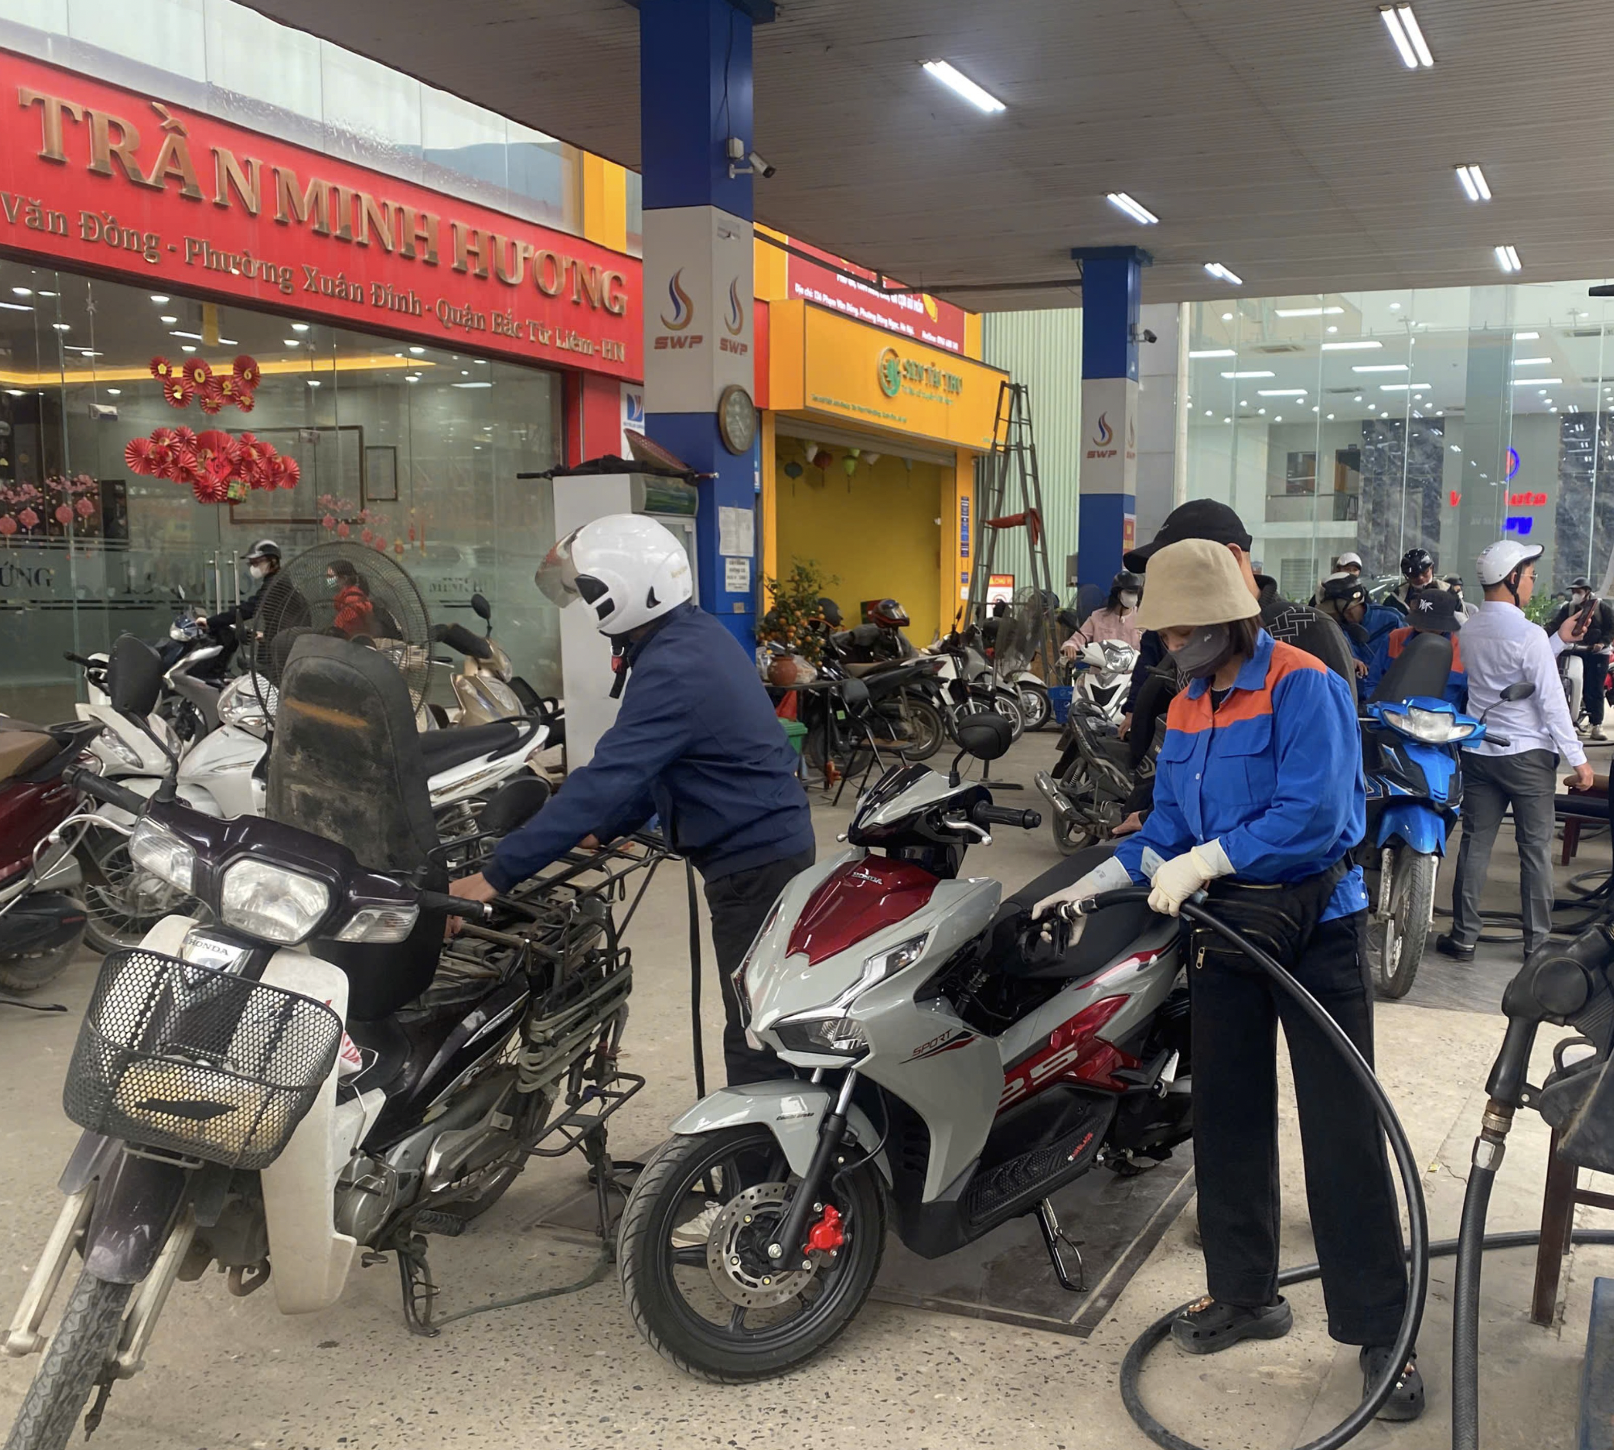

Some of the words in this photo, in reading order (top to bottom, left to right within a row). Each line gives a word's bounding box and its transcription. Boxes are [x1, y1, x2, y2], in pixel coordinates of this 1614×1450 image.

[17, 86, 265, 216] TRẦN
[271, 165, 441, 266] MINH
[450, 219, 628, 318] HƯƠNG
[0, 191, 69, 236] Văn
[78, 210, 161, 264] Đồng
[183, 235, 294, 295] Phường
[302, 264, 364, 303] Xuân
[435, 298, 486, 334] Quận
[491, 308, 523, 339] Bắc
[654, 334, 703, 350] SWP
[719, 337, 748, 356] SWP
[1086, 449, 1118, 459] SWP
[187, 938, 229, 957] HONDA
[912, 1028, 953, 1057] SPORT
